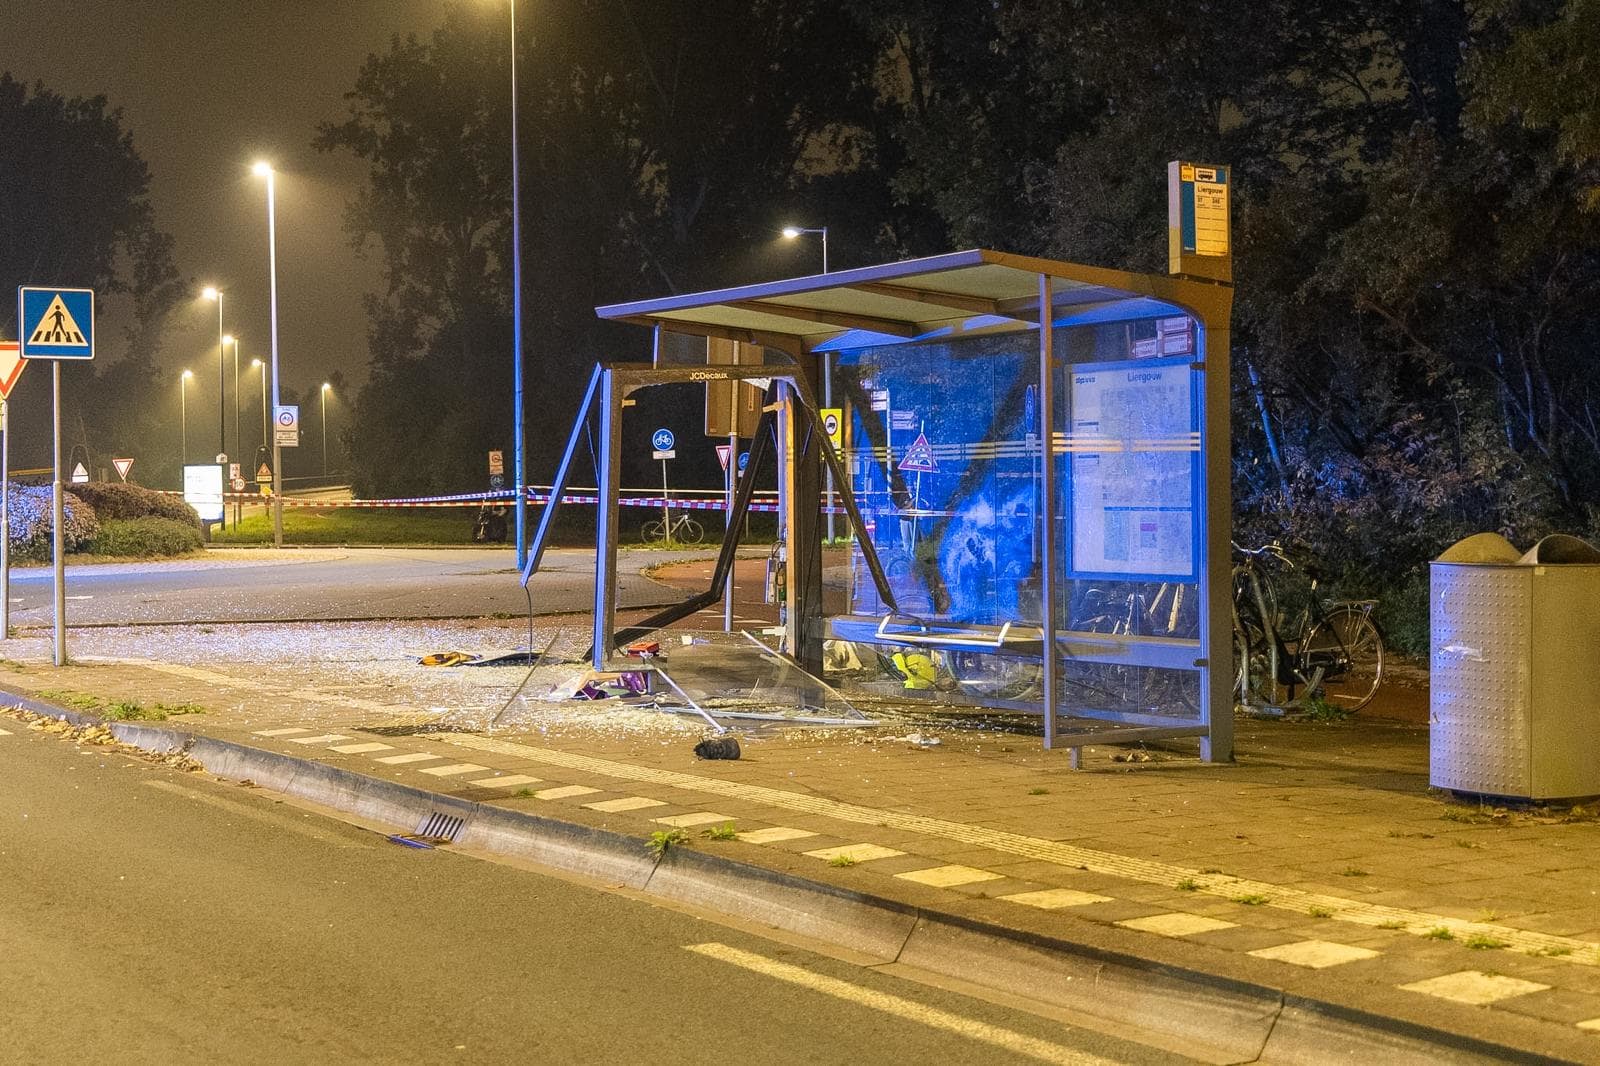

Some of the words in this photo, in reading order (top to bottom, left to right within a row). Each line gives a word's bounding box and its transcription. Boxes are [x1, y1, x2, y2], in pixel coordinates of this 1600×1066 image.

[1197, 186, 1224, 195] Liergouw
[689, 372, 728, 380] JCDecaux
[1127, 372, 1162, 383] Liergouw
